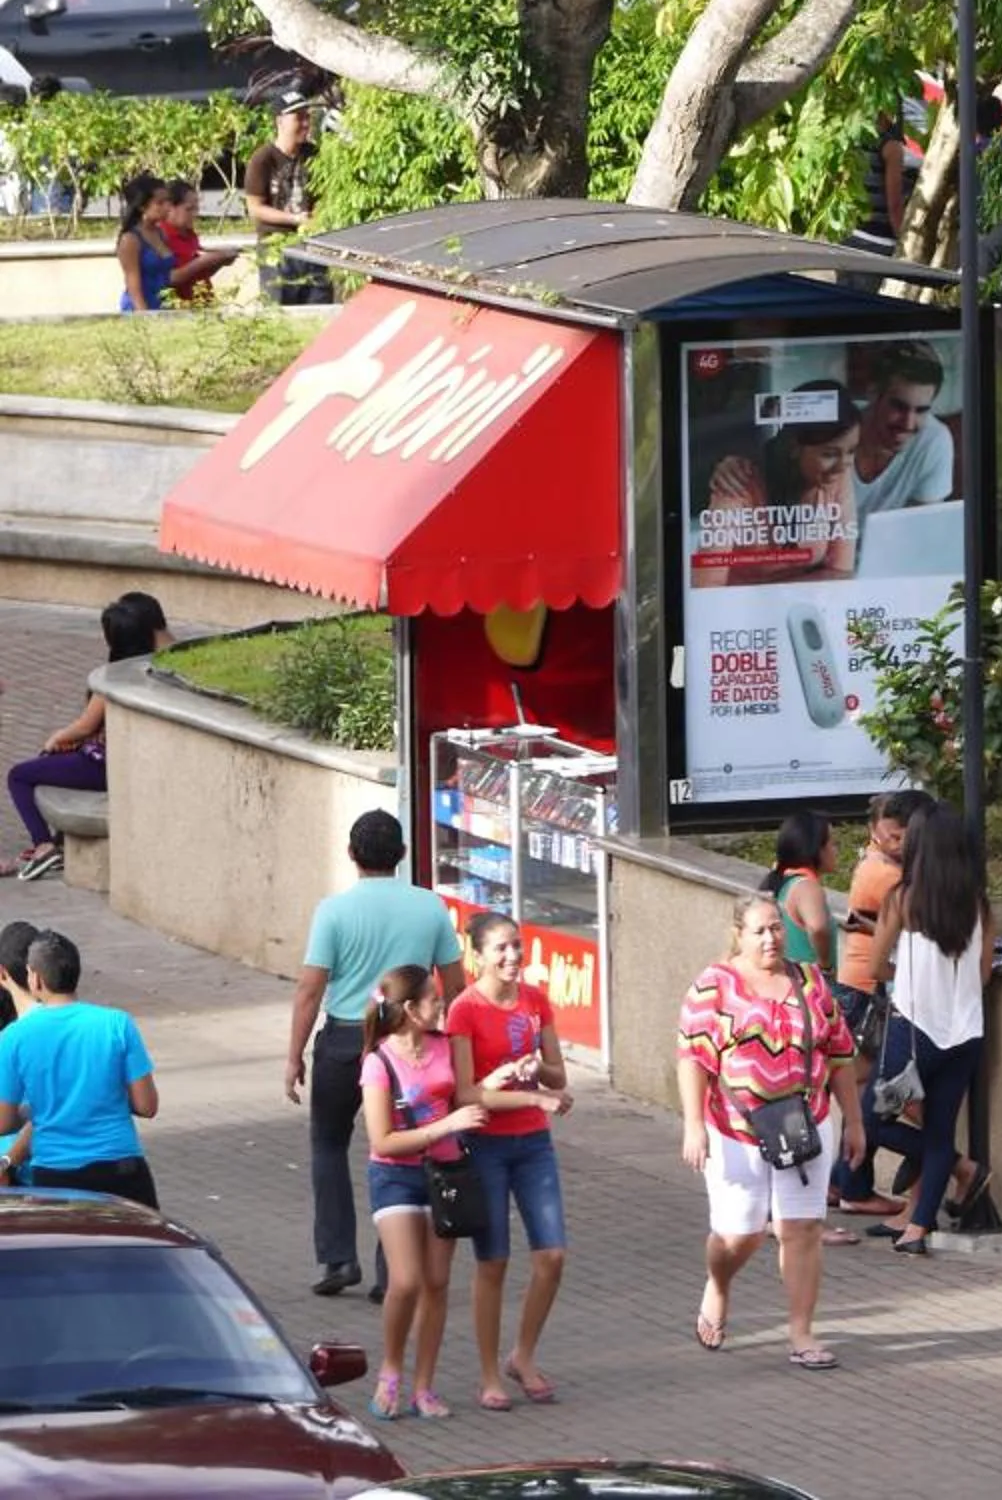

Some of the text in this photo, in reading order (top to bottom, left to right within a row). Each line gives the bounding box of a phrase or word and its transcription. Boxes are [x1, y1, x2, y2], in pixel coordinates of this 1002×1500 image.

[699, 354, 719, 369] 4G
[700, 503, 841, 528] CONECTIVIDAD
[700, 523, 859, 547] DONDE QUIERAS
[709, 628, 777, 651] RECIBE
[711, 651, 777, 673] DOBLE
[711, 672, 779, 687] CAPACIDAD
[711, 686, 779, 703] DE DATOS
